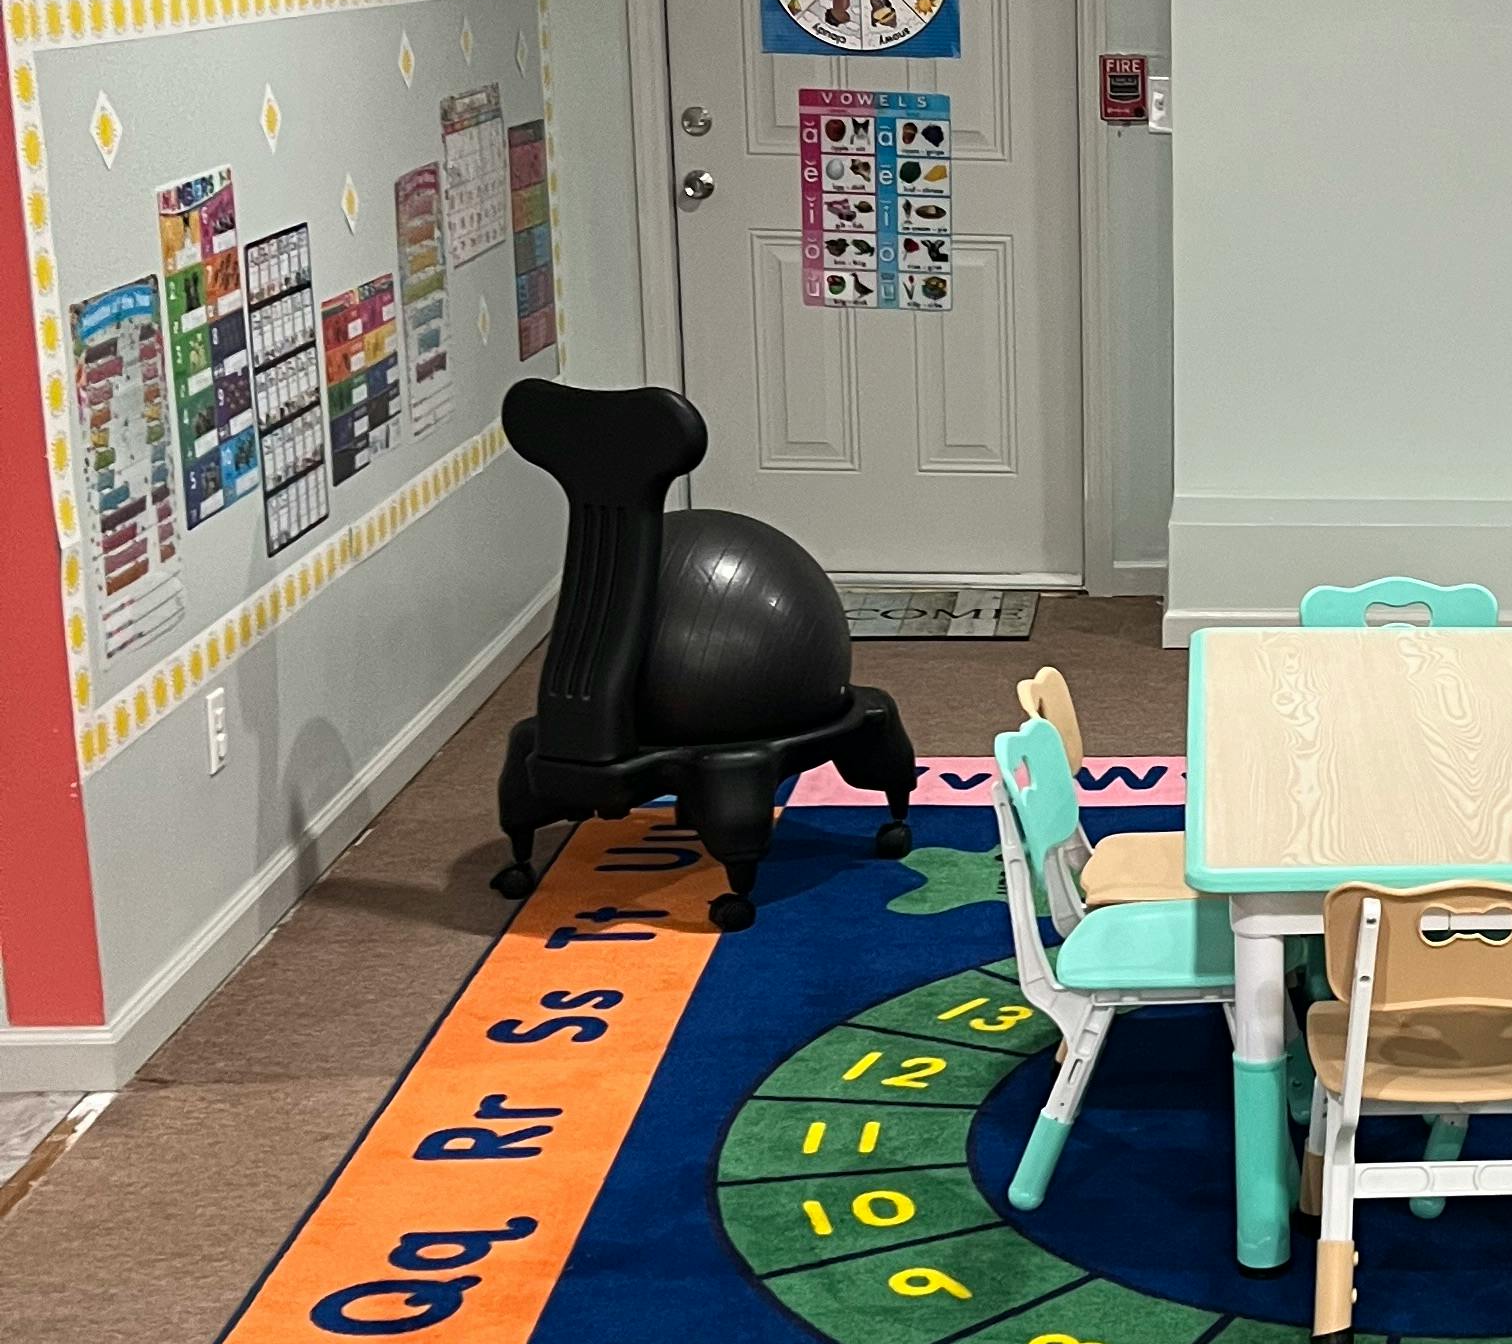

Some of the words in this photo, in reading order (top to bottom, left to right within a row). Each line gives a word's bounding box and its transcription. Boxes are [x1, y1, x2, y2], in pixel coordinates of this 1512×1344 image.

[812, 22, 848, 45] cloudy
[878, 26, 911, 46] snowy
[1106, 59, 1141, 73] FIRE
[821, 93, 928, 109] VOWELS
[1075, 765, 1186, 791] W
[543, 906, 671, 950] Tt
[485, 987, 625, 1044] Ss
[937, 997, 1035, 1032] 13
[842, 1051, 947, 1089] 12
[412, 1093, 564, 1162] Rr
[802, 1121, 881, 1155] 11
[802, 1190, 916, 1236] 10
[309, 1215, 540, 1336] Qq
[888, 1266, 973, 1300] 9
